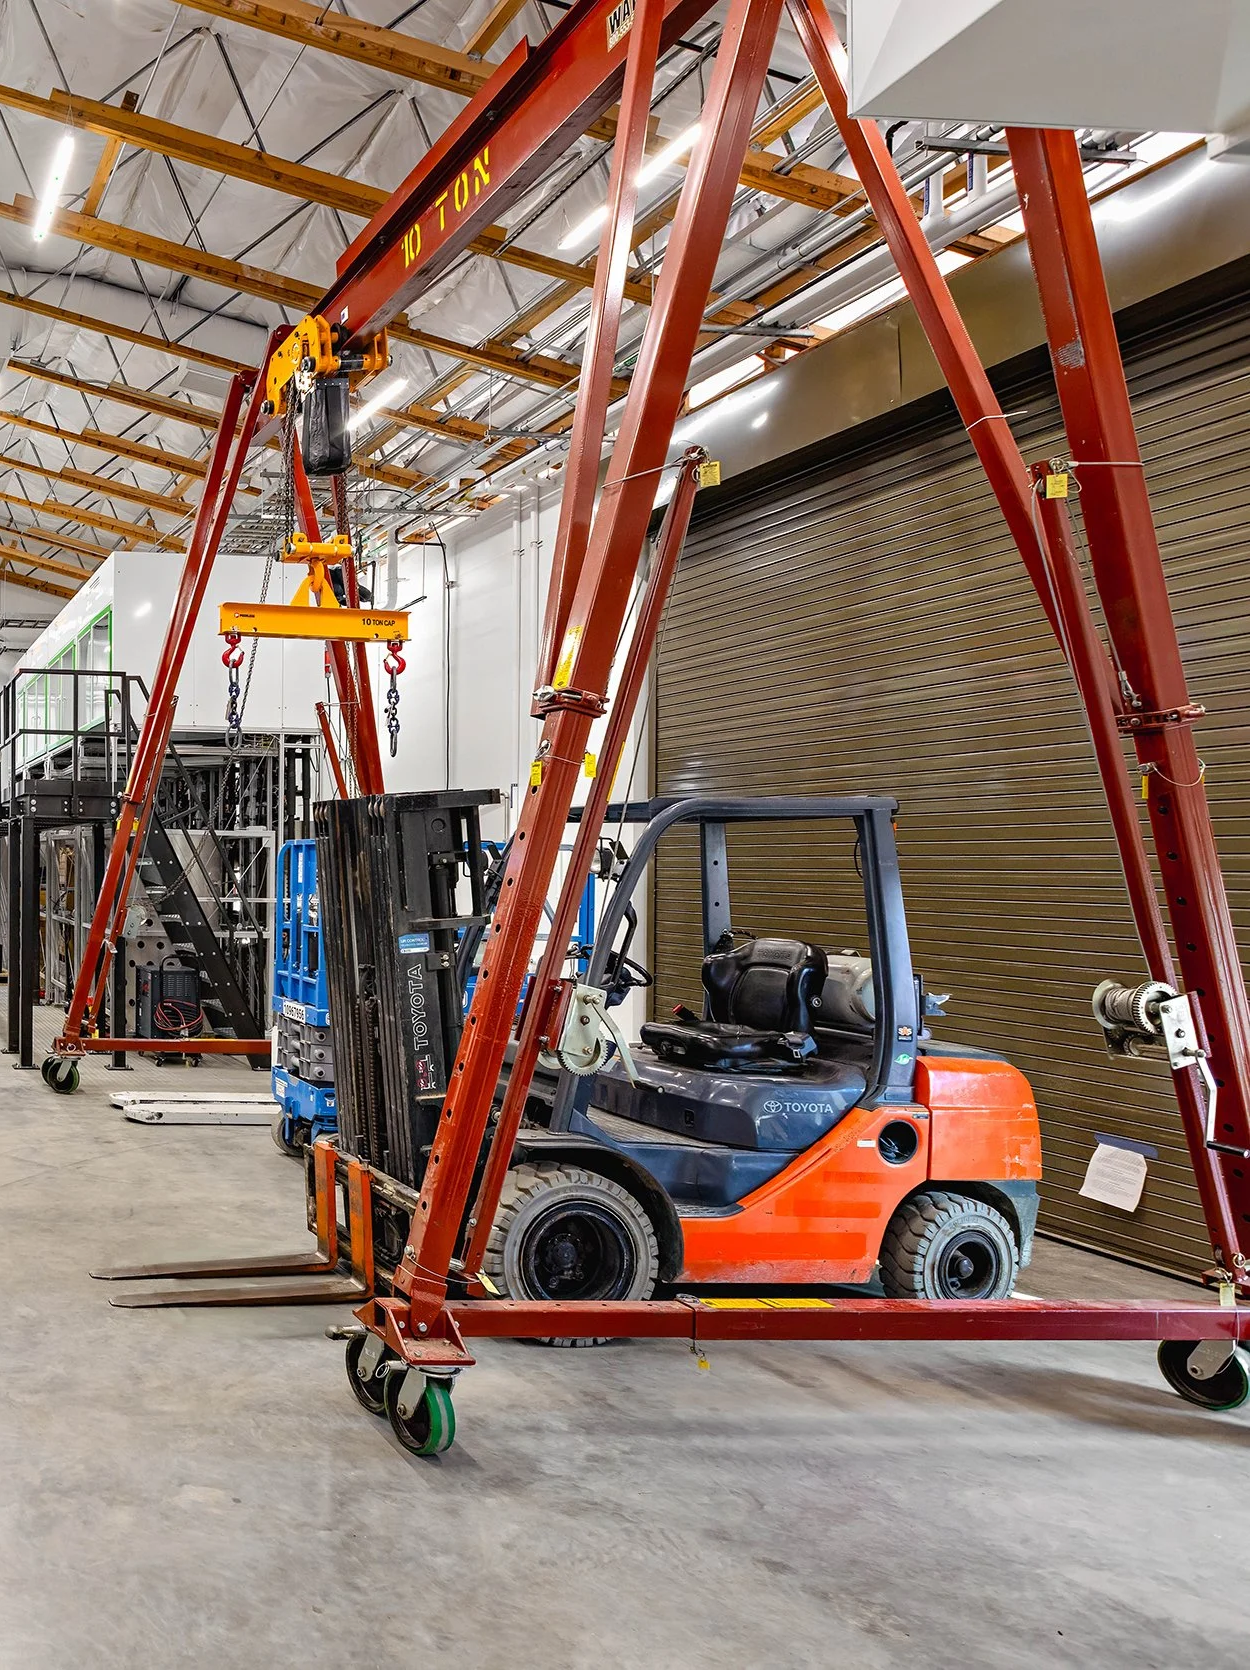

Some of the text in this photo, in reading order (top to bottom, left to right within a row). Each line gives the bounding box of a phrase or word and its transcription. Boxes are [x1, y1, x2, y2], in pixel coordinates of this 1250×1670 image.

[401, 146, 490, 268] 10 TON
[407, 963, 430, 1051] TOYOTA
[784, 1102, 834, 1114] TOYOTA
